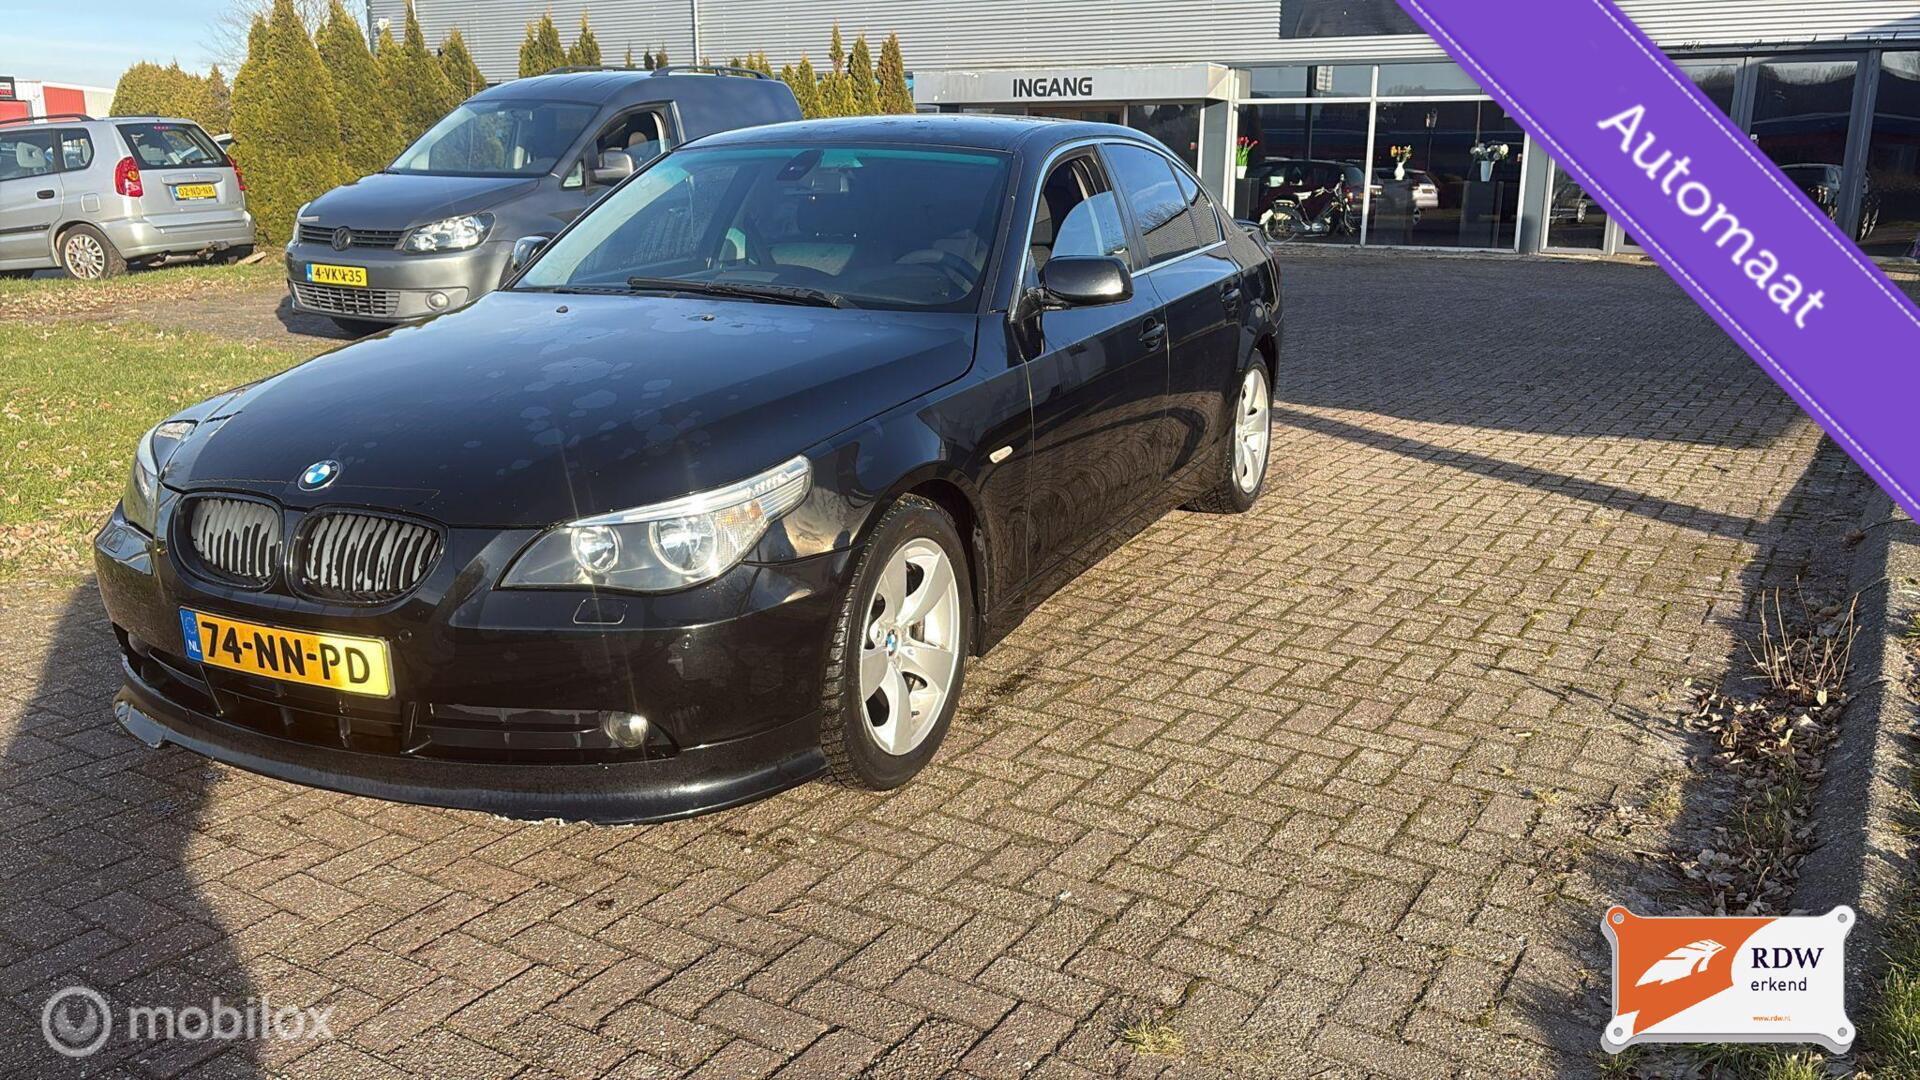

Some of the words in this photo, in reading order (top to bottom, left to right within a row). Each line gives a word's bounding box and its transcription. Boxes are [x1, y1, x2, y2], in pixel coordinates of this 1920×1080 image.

[1012, 76, 1093, 98] INGANG
[187, 639, 201, 653] NL
[200, 621, 371, 684] 74-NN-PD
